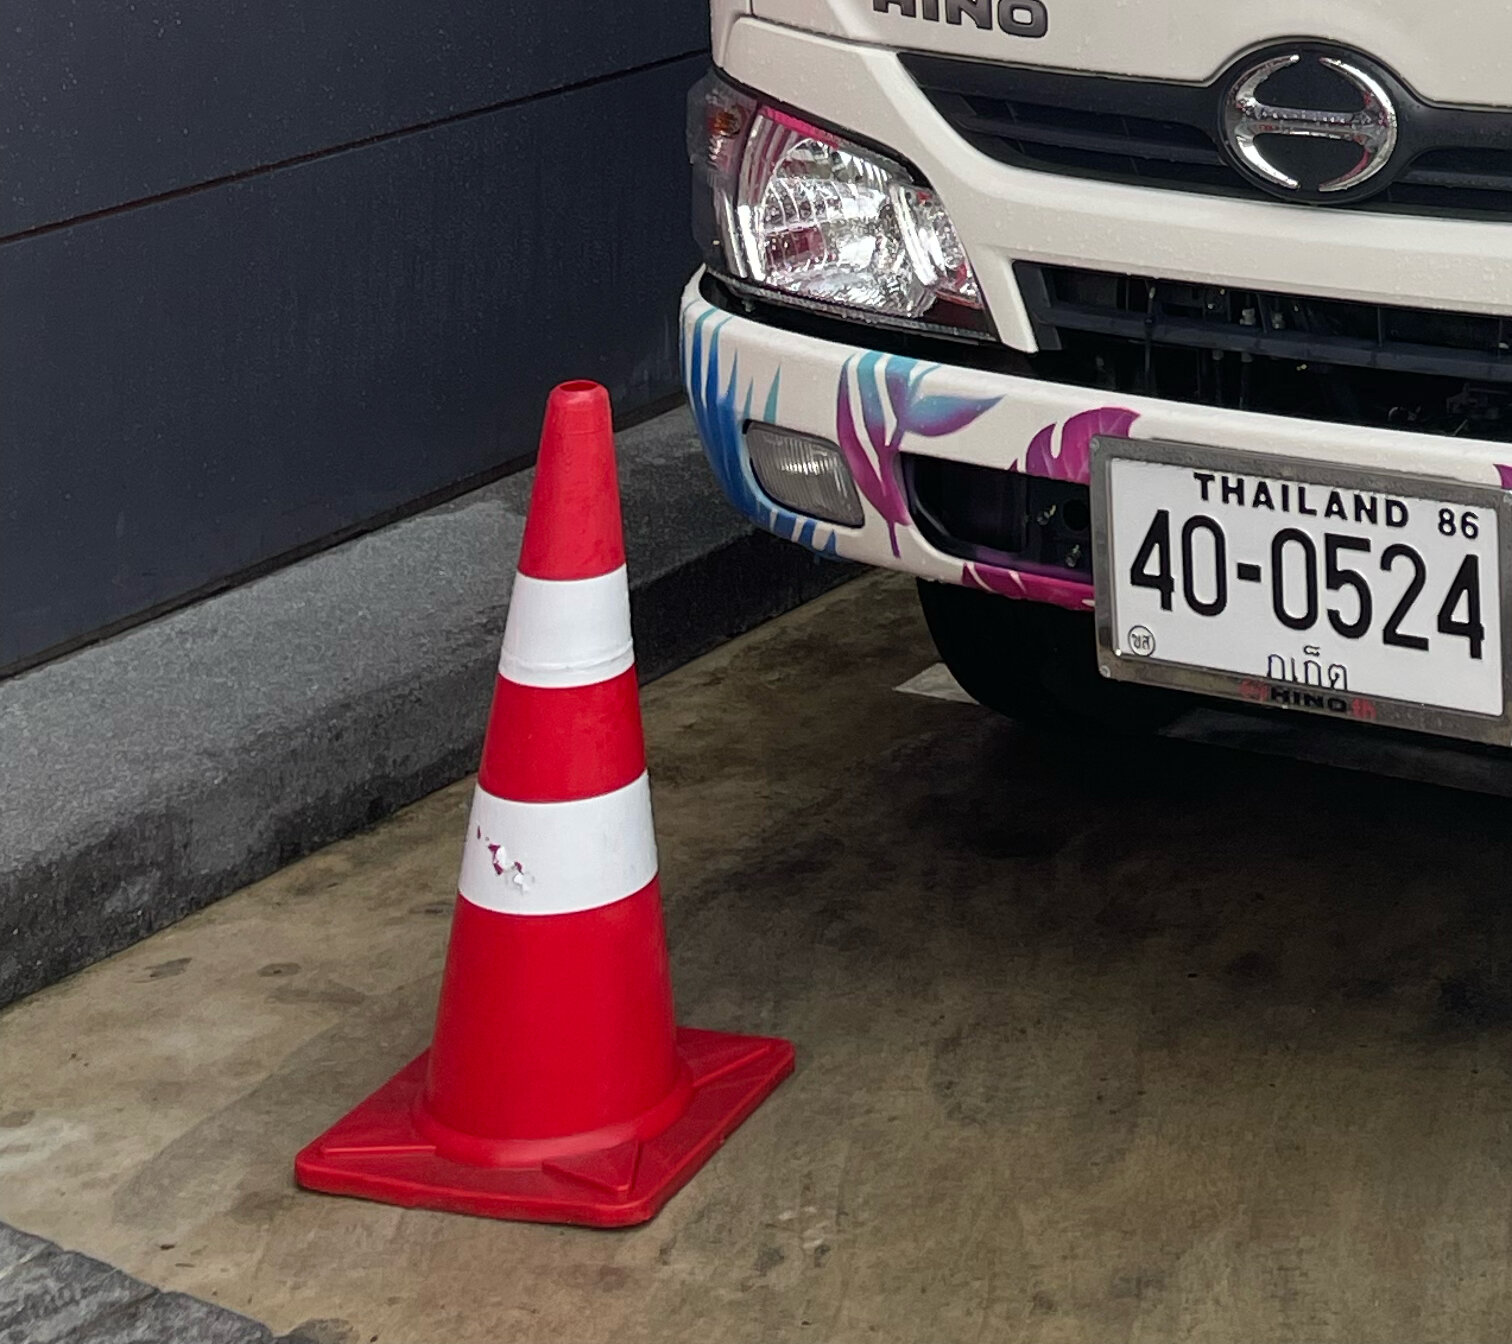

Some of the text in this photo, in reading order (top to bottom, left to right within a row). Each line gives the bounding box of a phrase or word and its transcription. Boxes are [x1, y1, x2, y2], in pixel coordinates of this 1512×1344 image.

[1194, 472, 1480, 540] THAILAND 86
[1130, 509, 1485, 661] 40-0524
[1267, 644, 1348, 691] ภเก็ต
[1271, 686, 1348, 713] HINO
